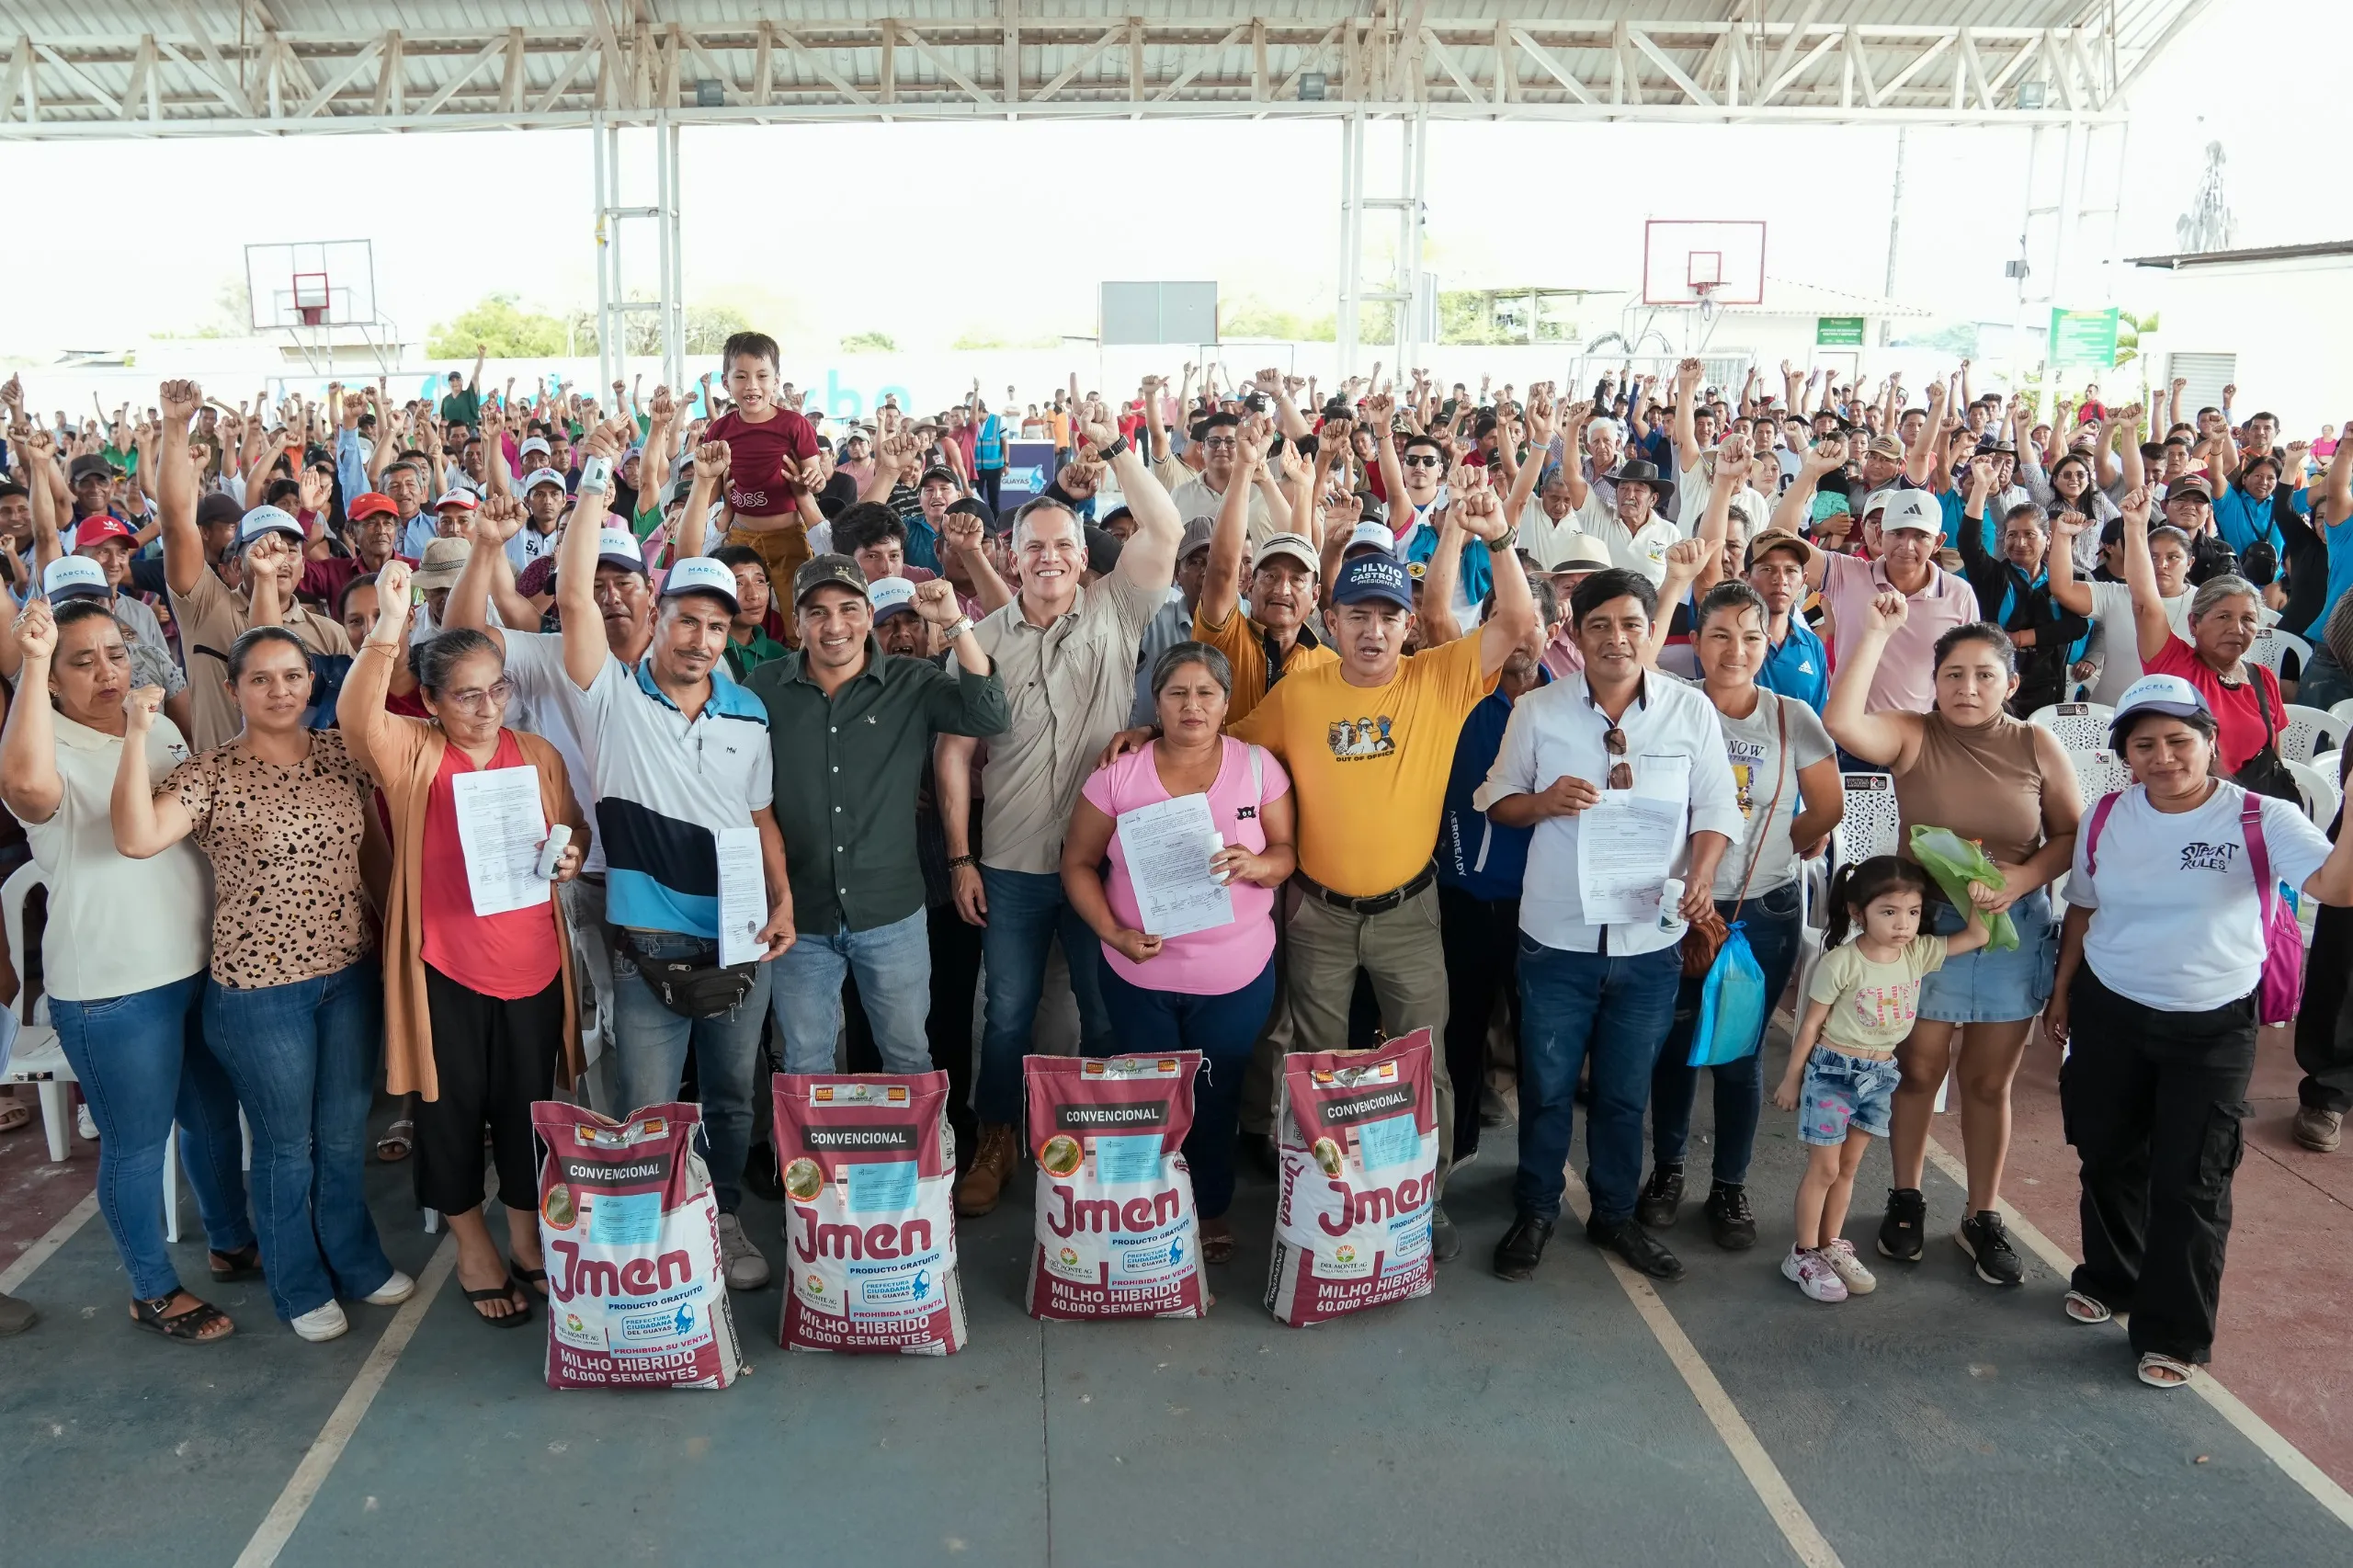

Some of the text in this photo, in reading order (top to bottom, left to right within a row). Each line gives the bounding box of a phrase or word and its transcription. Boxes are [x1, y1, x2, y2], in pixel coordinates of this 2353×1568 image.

[254, 512, 294, 522] MARCELA
[526, 540, 539, 556] 54
[56, 569, 96, 580] MARCELA
[688, 566, 732, 584] MARCELA
[1350, 572, 1393, 583] CASTRO
[1357, 579, 1397, 588] PRESIDENTE
[874, 588, 912, 601] MARCELA
[2125, 684, 2173, 700] MARCELA
[1367, 750, 1395, 760] OFFICE
[2180, 858, 2227, 872] RULES
[1327, 1091, 1408, 1119] CONVENCIONAL
[1066, 1108, 1160, 1122] CONVENCIONAL
[811, 1132, 906, 1144] CONVENCIONAL
[570, 1163, 660, 1180] CONVENCIONAL
[1318, 1168, 1436, 1237] Jmen
[1047, 1186, 1180, 1239] Jmen
[1390, 1214, 1423, 1231] PRODUCTO
[794, 1205, 931, 1264] Jmen
[1112, 1219, 1190, 1245] PRODUCTO GRATUITO
[1127, 1248, 1167, 1259] PREFECTURA
[1127, 1253, 1168, 1264] CIUDADANA
[850, 1253, 939, 1274] PRODUCTO GRATUITO
[1061, 1265, 1083, 1275] MONTE
[1142, 1258, 1167, 1267] GUAYAS
[1384, 1258, 1419, 1274] PROHIBIDA
[551, 1240, 692, 1303] Jmen
[1111, 1278, 1157, 1286] PROHIBIDA
[1172, 1264, 1194, 1278] VENTA
[1318, 1260, 1428, 1299] MILHO HIBRIDO
[866, 1279, 909, 1289] PREFECTURA
[867, 1285, 911, 1294] CIUDADANA
[1051, 1280, 1181, 1302] MILHO HIBRIDO
[608, 1285, 703, 1310] PRODUCTO GRATUITO
[806, 1292, 826, 1303] MONTE
[882, 1290, 910, 1299] GUAYAS
[1316, 1274, 1427, 1312] 60.000 SEMENTES
[917, 1298, 943, 1312] VENTA
[1051, 1295, 1182, 1313] 60.000 SEMENTES
[626, 1314, 671, 1325] PREFECTURA
[626, 1319, 673, 1330] CIUDADANA
[800, 1306, 930, 1335] MILHO HIBRIDO
[567, 1330, 590, 1340] MONTE
[642, 1325, 672, 1335] GUAYAS
[799, 1324, 932, 1346] 60.000 SEMENTES
[614, 1346, 663, 1355] PROHIBIDA
[682, 1333, 709, 1347] VENTA
[561, 1348, 696, 1371] MILHO HIBRIDO
[562, 1366, 699, 1383] 60.000 SEMENTES
